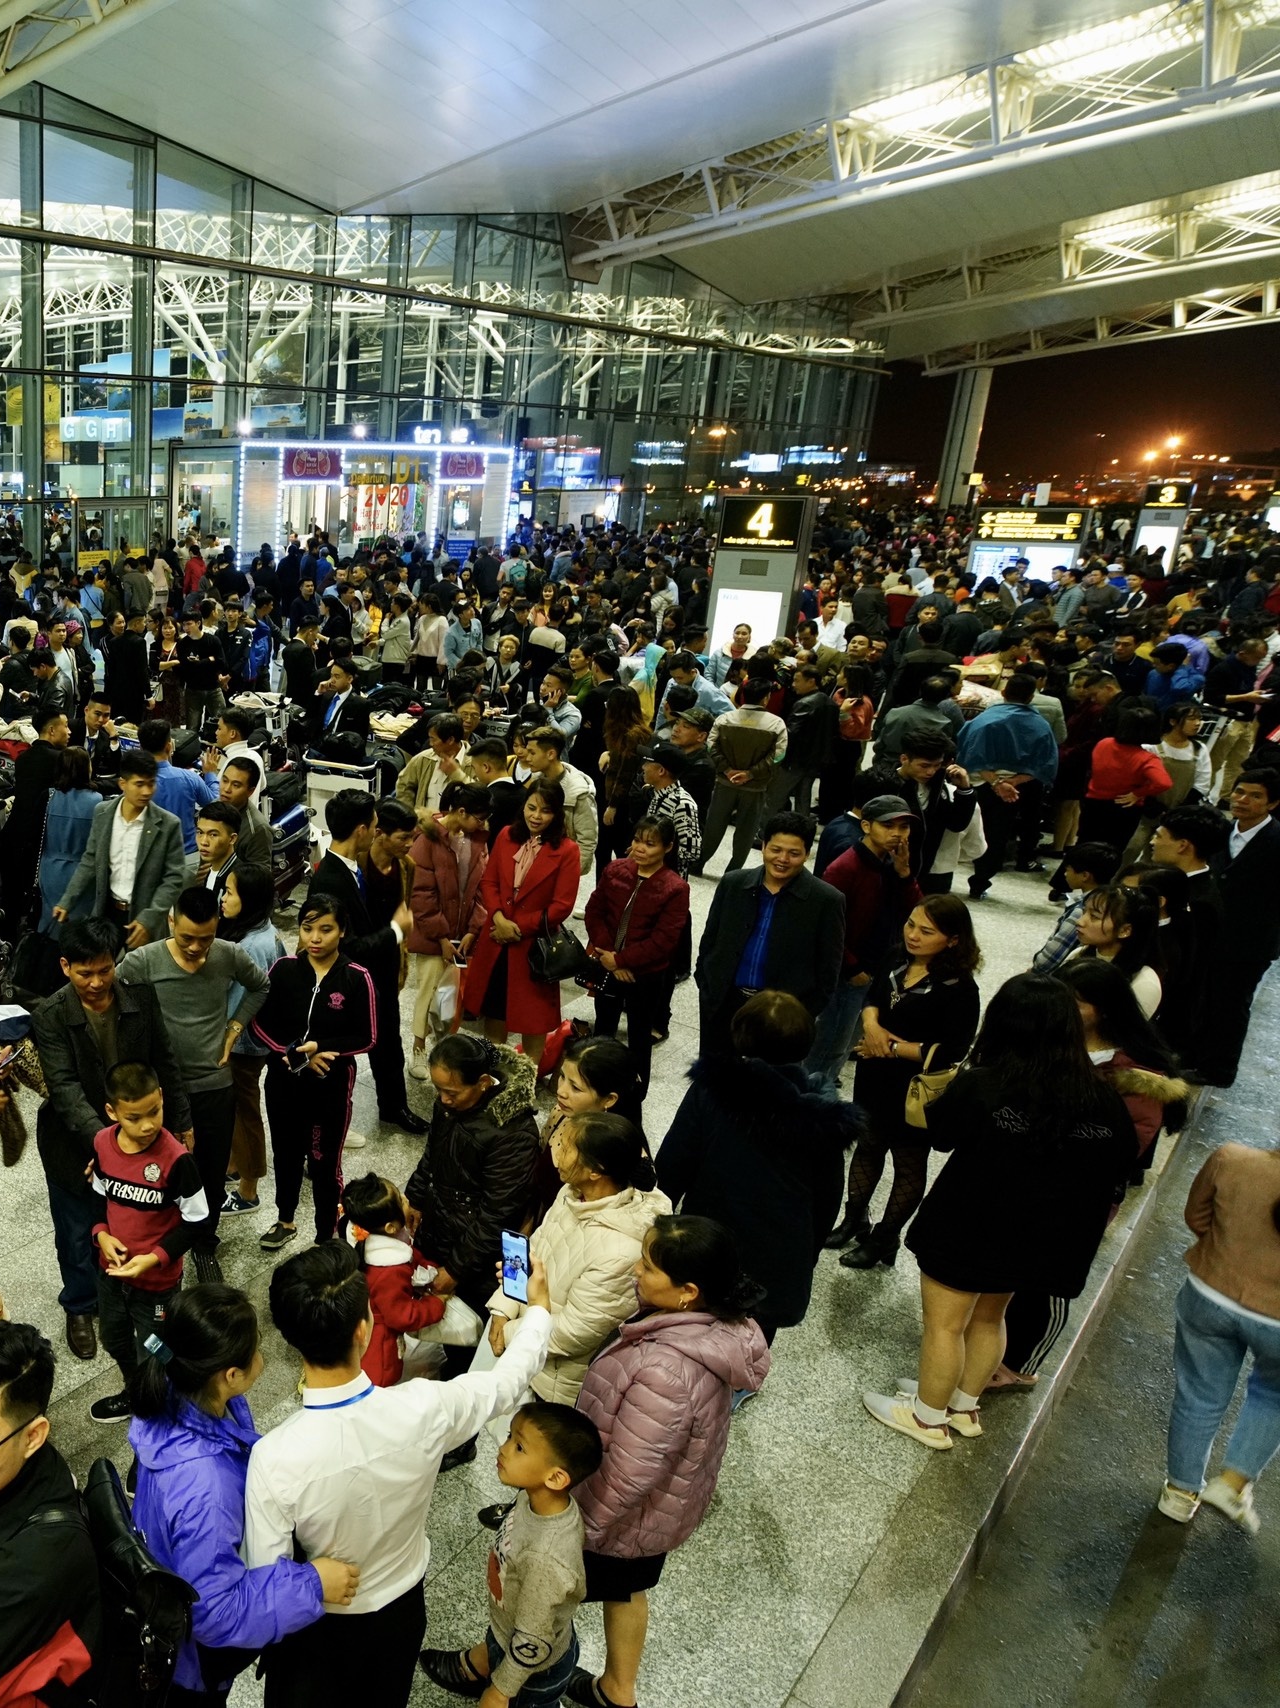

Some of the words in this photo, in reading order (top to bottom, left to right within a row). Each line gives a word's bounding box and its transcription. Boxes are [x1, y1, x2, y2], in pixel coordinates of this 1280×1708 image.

[64, 421, 75, 439] G
[86, 420, 98, 438] G
[107, 422, 117, 439] H
[1159, 486, 1177, 503] 3
[747, 503, 774, 537] 4
[112, 1182, 165, 1204] FASHION
